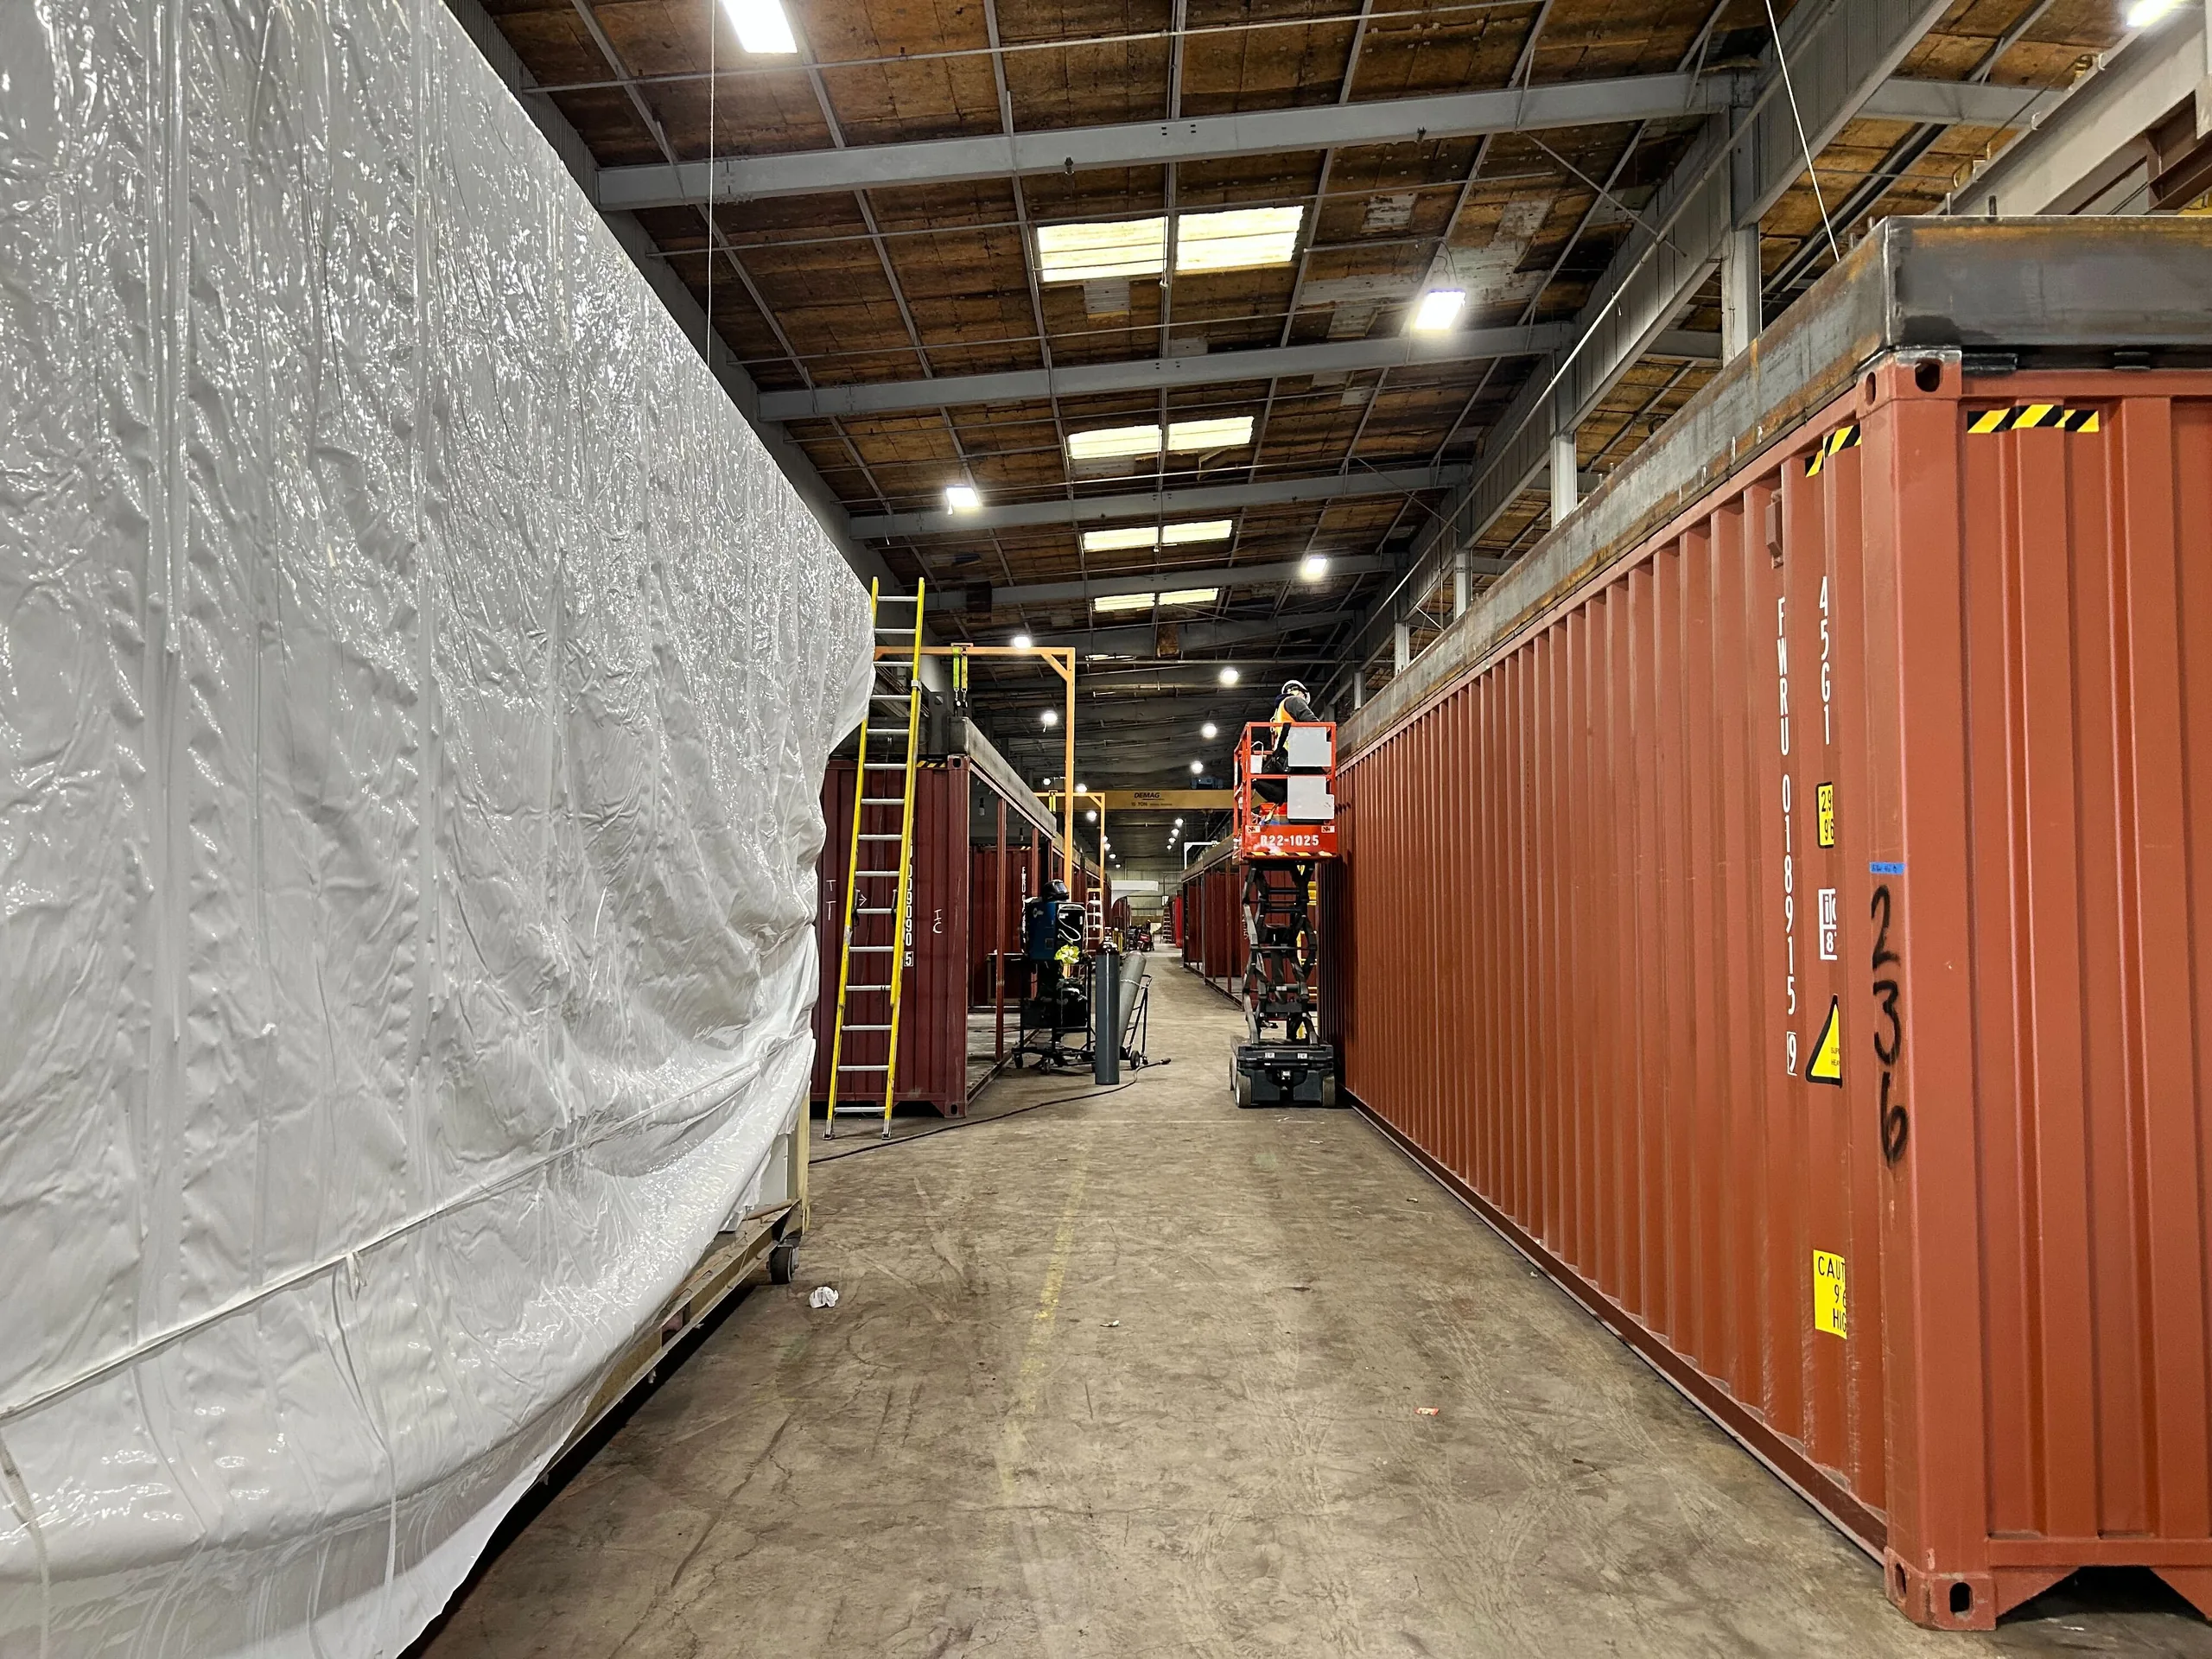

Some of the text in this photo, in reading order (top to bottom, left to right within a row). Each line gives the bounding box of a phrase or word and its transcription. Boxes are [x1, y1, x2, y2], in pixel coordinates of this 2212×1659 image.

[1819, 576, 1831, 745] 45G1
[1777, 596, 1796, 1075] FWRU 018915 9
[1871, 884, 1909, 1168] 236
[1818, 1255, 1846, 1282] CAUT
